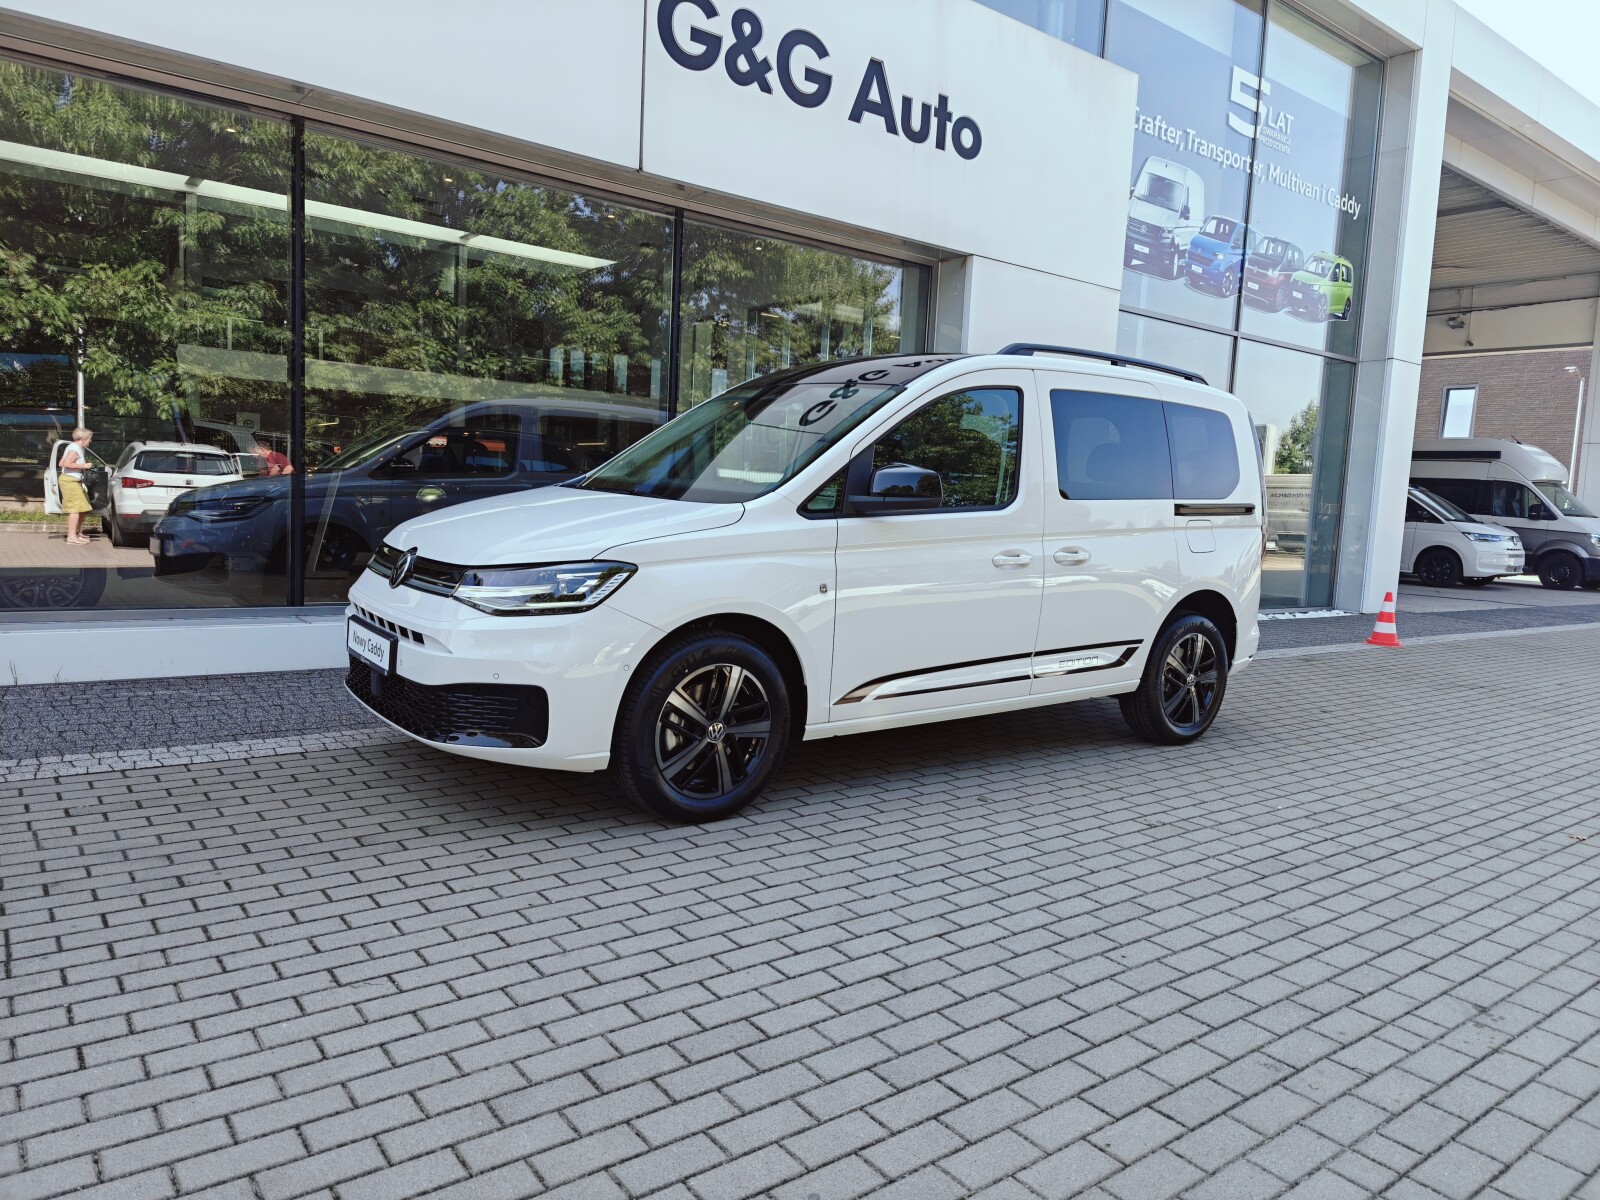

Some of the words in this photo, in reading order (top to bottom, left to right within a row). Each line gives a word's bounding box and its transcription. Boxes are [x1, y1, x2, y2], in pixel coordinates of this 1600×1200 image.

[657, 0, 833, 108] G&G
[848, 57, 983, 160] Auto
[1229, 65, 1271, 138] 5
[1268, 106, 1295, 135] LAT
[1187, 128, 1266, 184] Transporter,
[1269, 162, 1320, 201] Multivan
[1321, 184, 1327, 203] i
[1327, 187, 1362, 221] Caddy
[352, 630, 367, 653] Nowy
[367, 638, 385, 663] Caddy
[1058, 655, 1100, 669] EDITION
